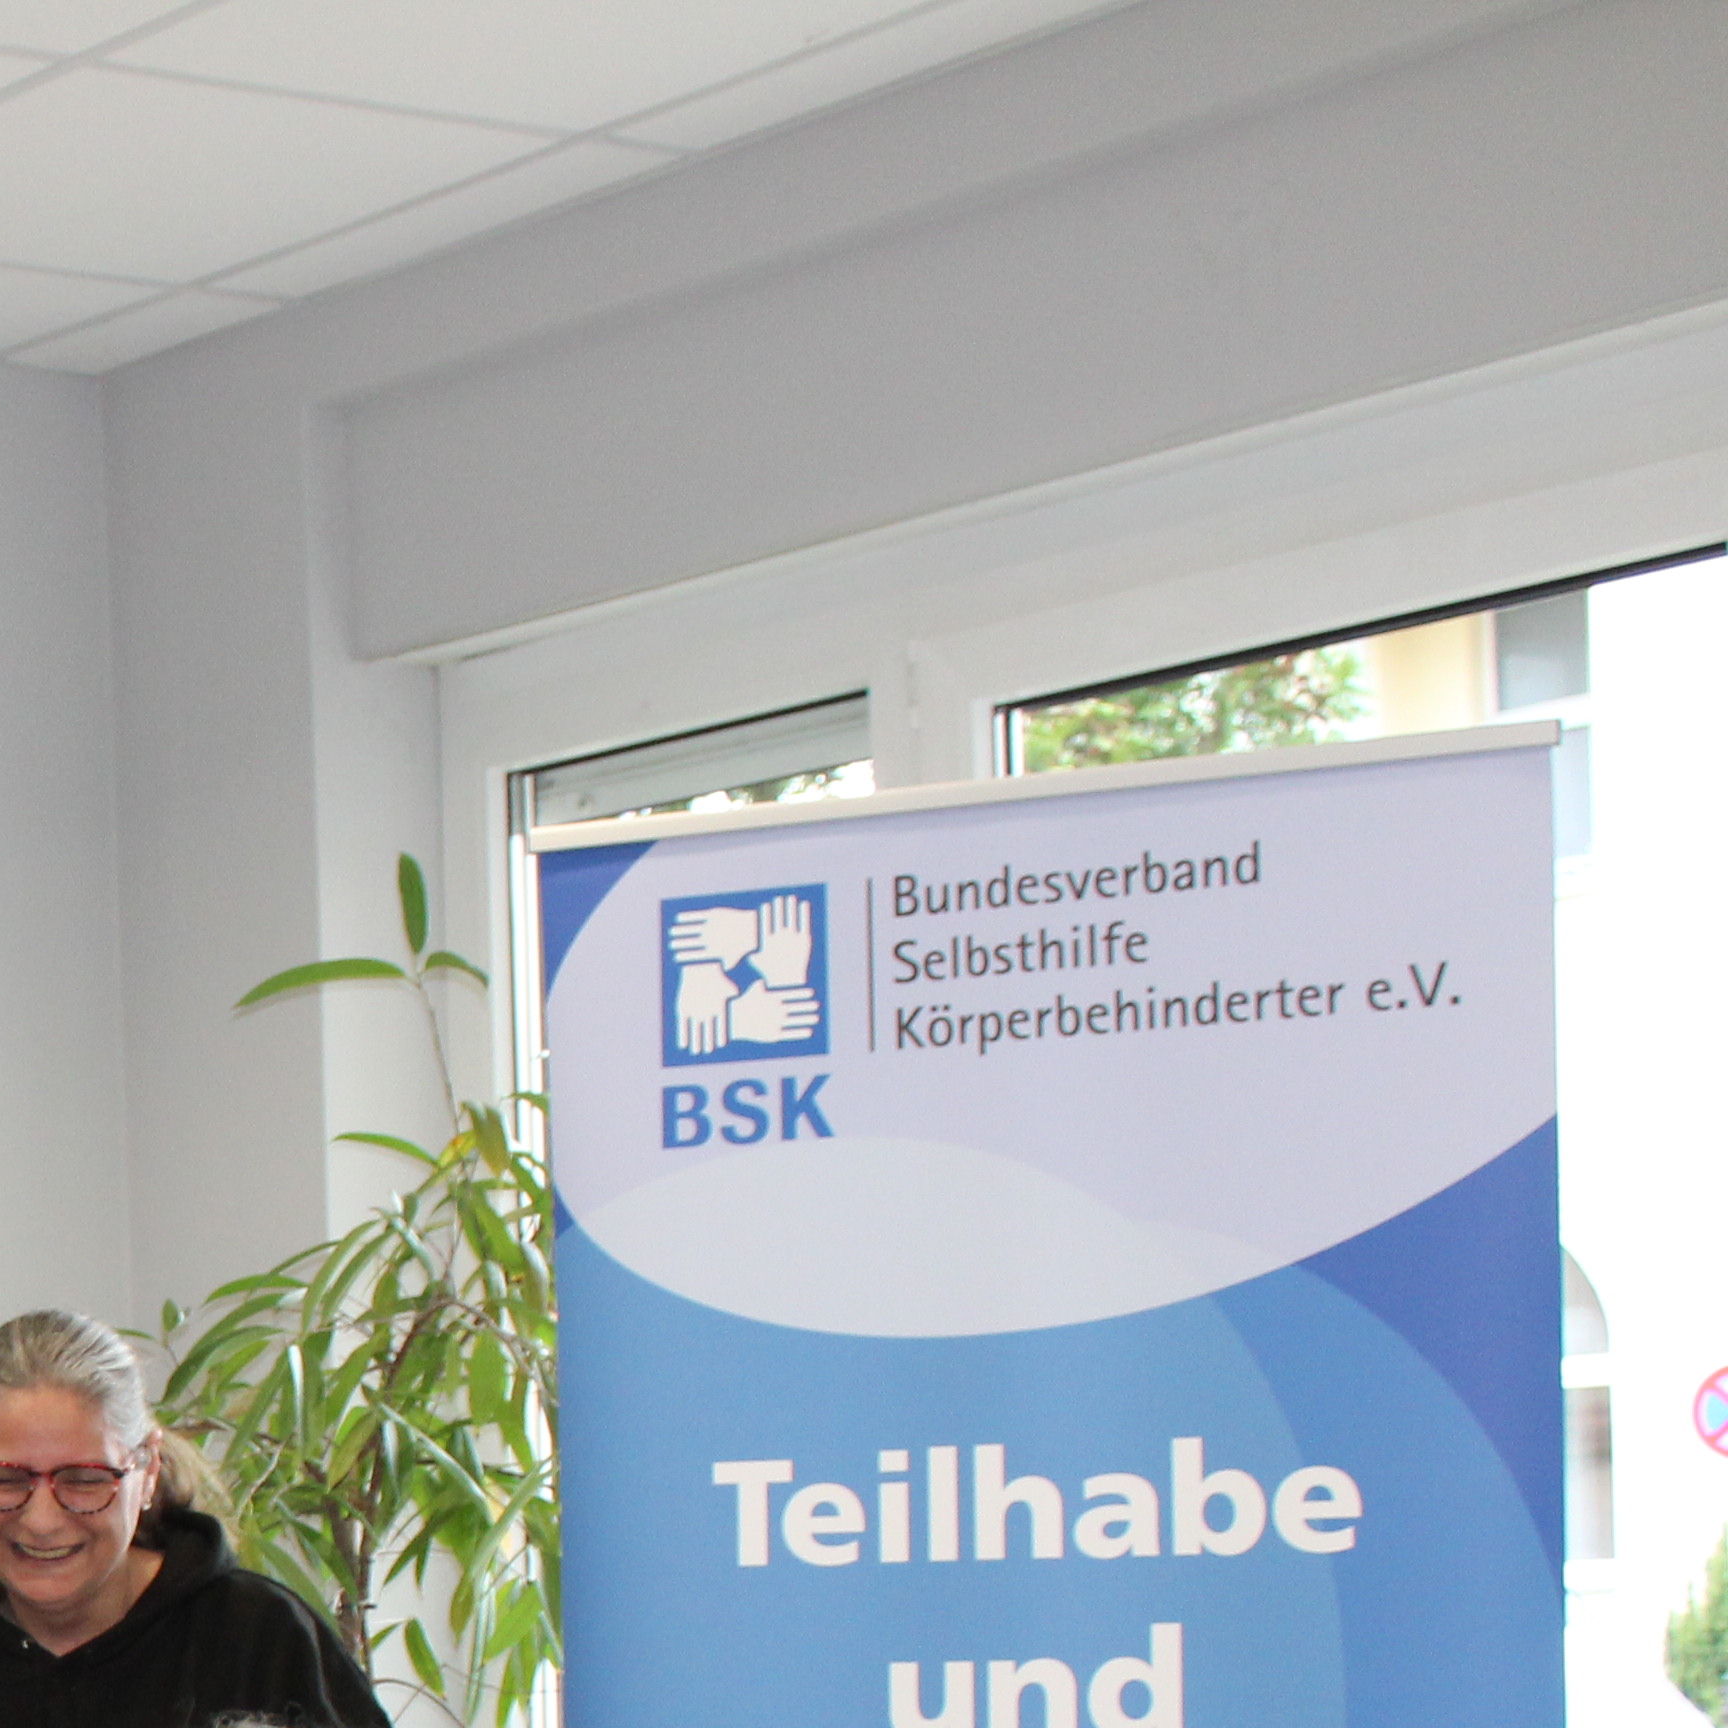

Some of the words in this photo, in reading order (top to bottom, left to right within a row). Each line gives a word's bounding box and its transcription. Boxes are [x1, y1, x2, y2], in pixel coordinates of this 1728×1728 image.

[892, 840, 1262, 918] Bundesverband
[892, 920, 1150, 984] Selbsthilfe
[894, 973, 1346, 1056] Körperbehinderter
[1366, 960, 1462, 1013] e.V.
[661, 1073, 836, 1150] BSK
[712, 1436, 1364, 1567] Teilhabe
